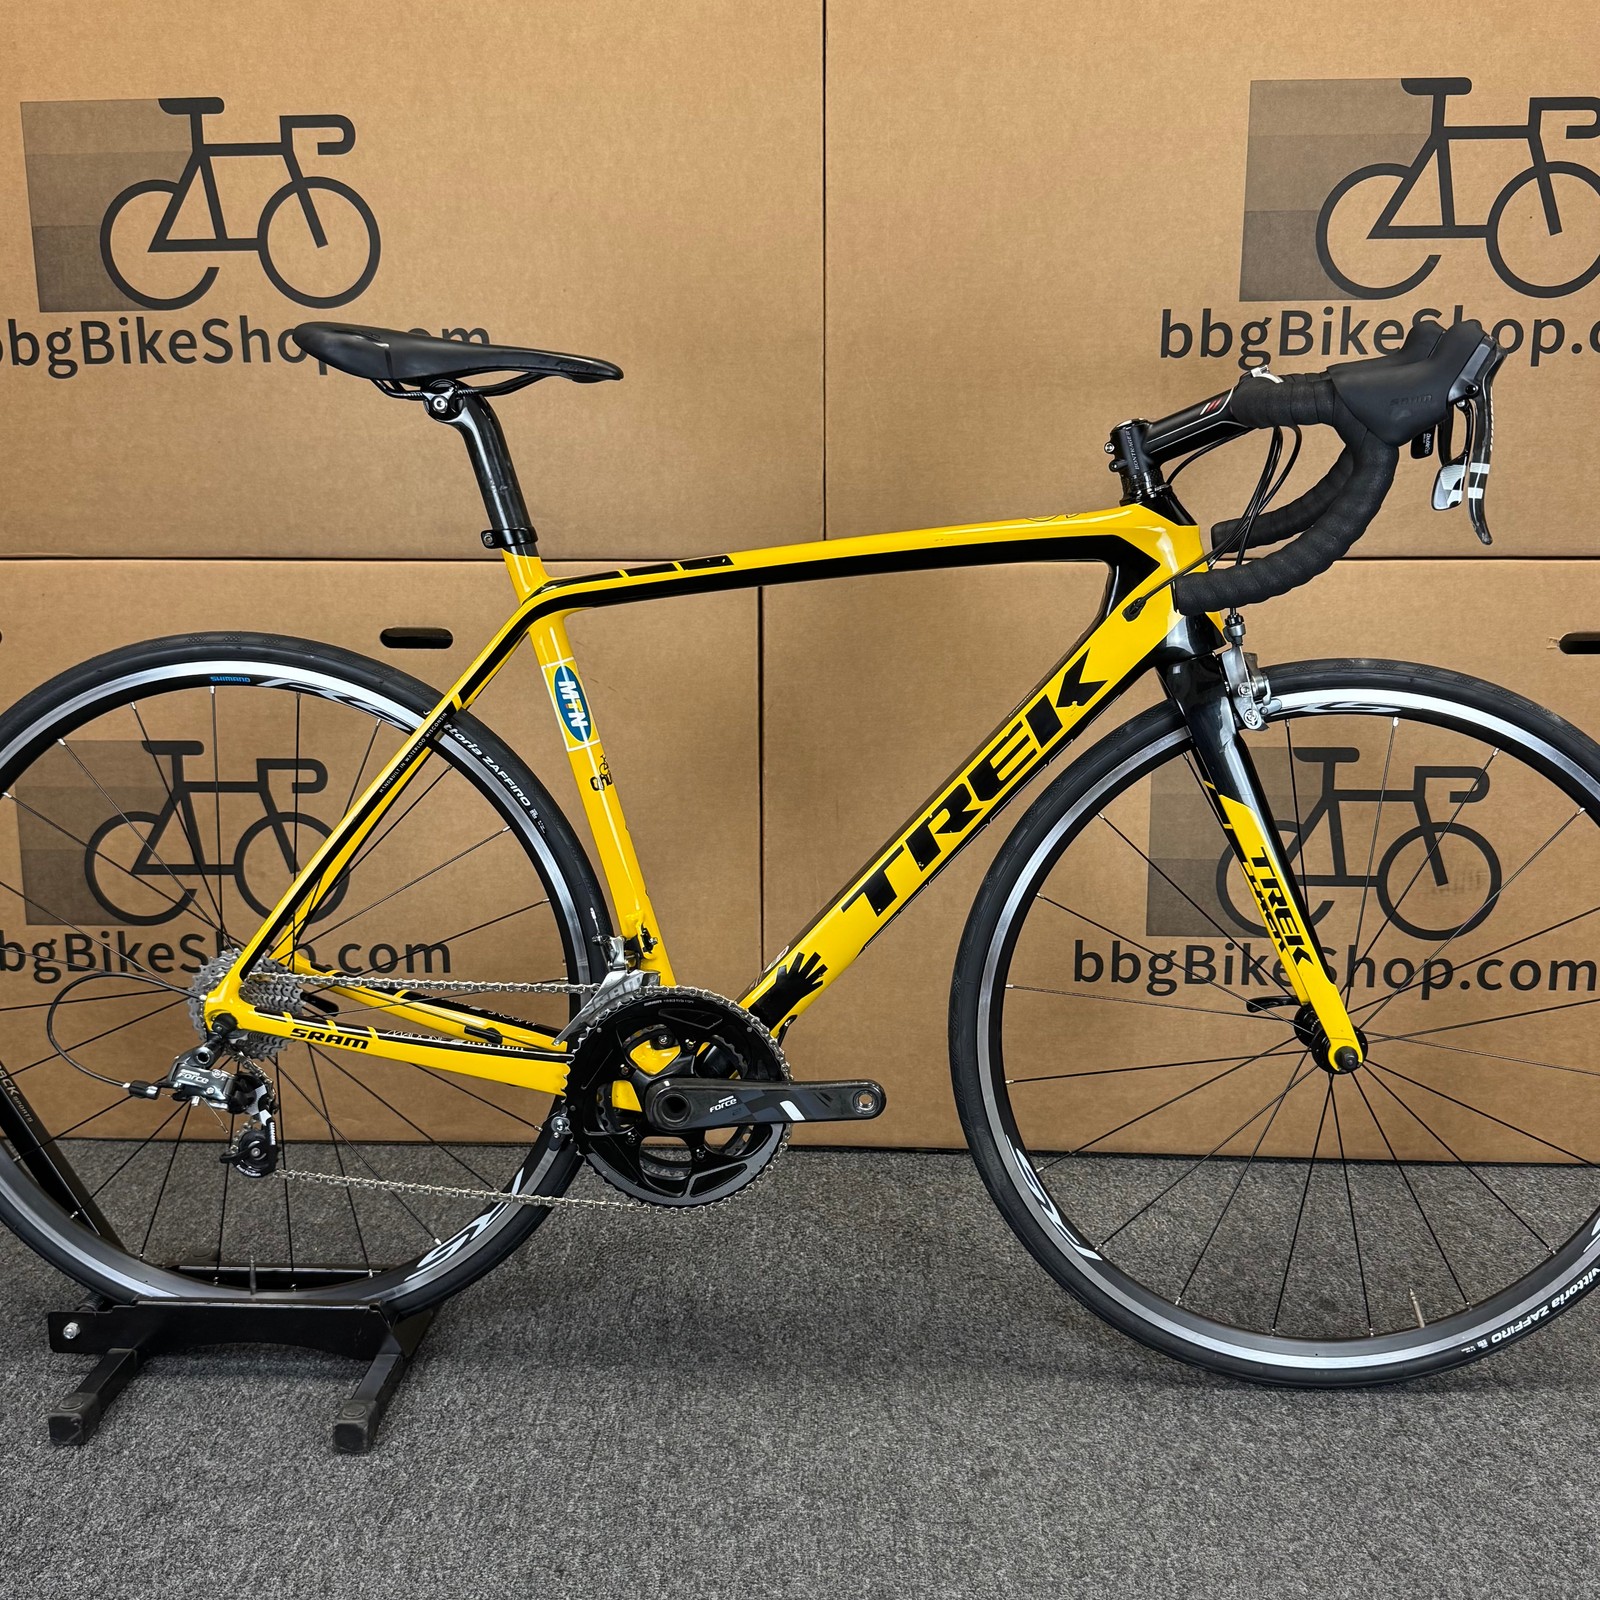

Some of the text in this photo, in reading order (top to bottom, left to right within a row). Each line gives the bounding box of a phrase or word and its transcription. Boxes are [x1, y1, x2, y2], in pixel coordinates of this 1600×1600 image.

[210, 675, 251, 683] SHIMANO
[557, 680, 589, 727] MTN
[379, 712, 447, 793] HANDBUILT IN WATERLOO WISCONSIN
[482, 755, 531, 806] ZAFFIRO
[841, 647, 1109, 917] TREK
[1251, 846, 1314, 966] TREK
[290, 1028, 369, 1050] SRAM
[13, 1095, 34, 1122] SPORTS
[1491, 1267, 1600, 1344] vittoria ZAFFIRO
